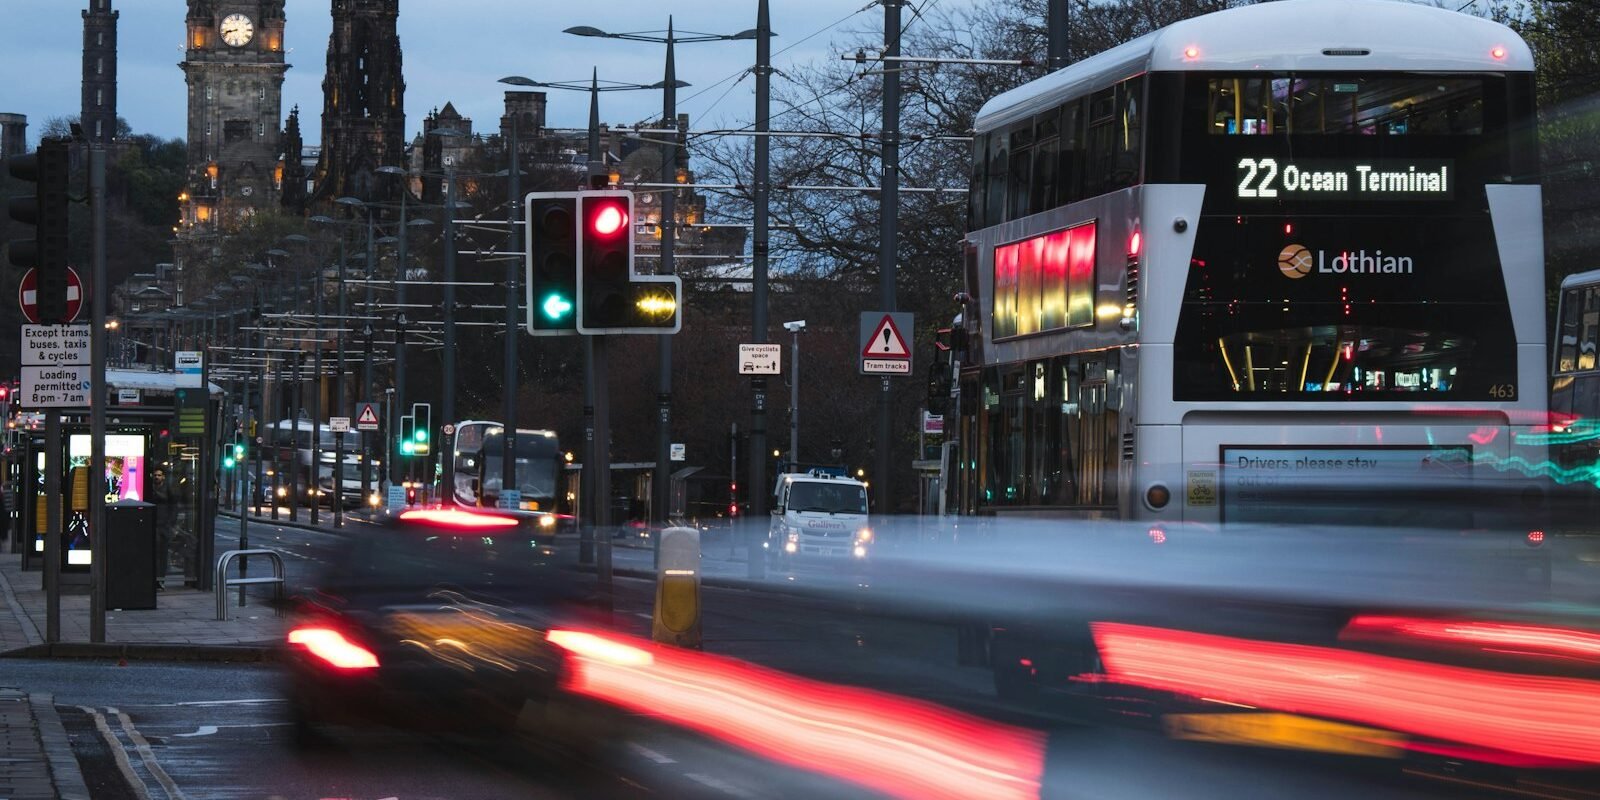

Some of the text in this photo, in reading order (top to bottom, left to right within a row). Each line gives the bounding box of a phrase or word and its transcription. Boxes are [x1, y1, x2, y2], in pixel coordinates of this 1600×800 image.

[1237, 158, 1447, 198] 22 Ocean Terminal
[1318, 249, 1413, 274] Lothian
[25, 328, 58, 338] Except
[64, 339, 87, 349] taxis
[38, 351, 78, 362] & cycles
[39, 370, 77, 381] Loading
[34, 382, 81, 392] permitted
[1488, 384, 1515, 398] 463
[1295, 456, 1343, 473] please
